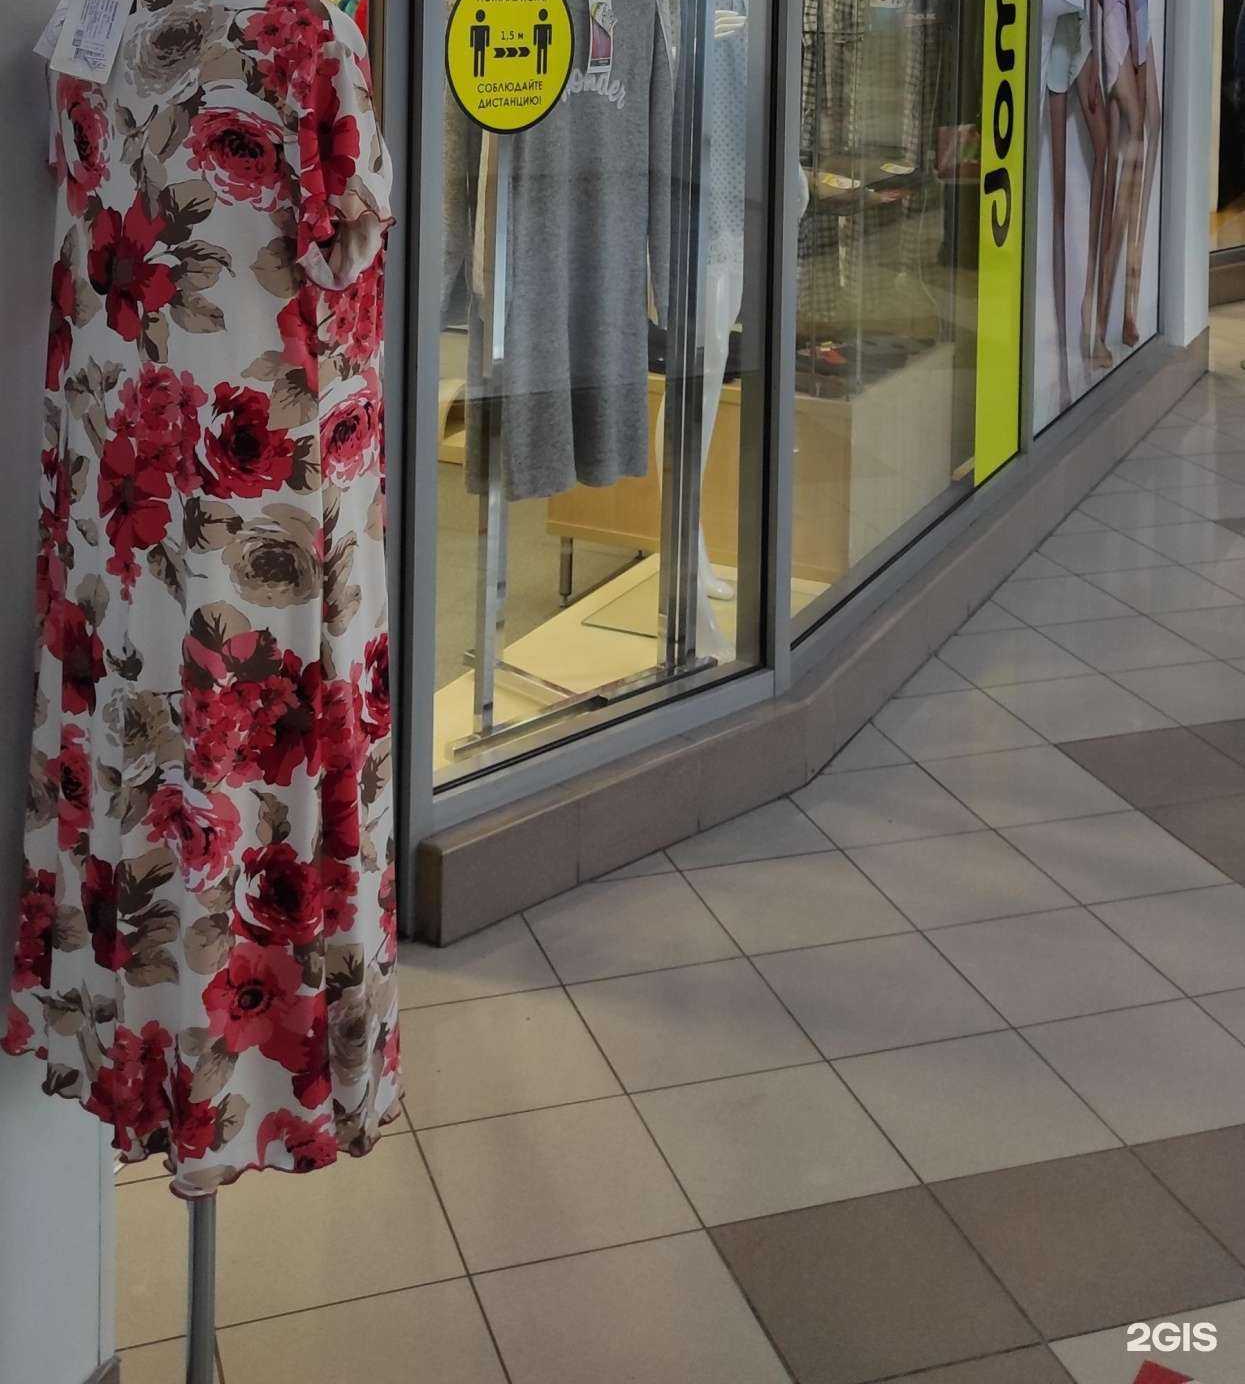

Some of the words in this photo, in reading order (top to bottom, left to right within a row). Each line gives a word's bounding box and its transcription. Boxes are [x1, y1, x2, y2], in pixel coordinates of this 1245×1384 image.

[501, 31, 515, 42] 1,5
[477, 79, 543, 94] СОБЛЮДАЙТЕ
[478, 96, 542, 110] ДИСТАНЦИЮ!
